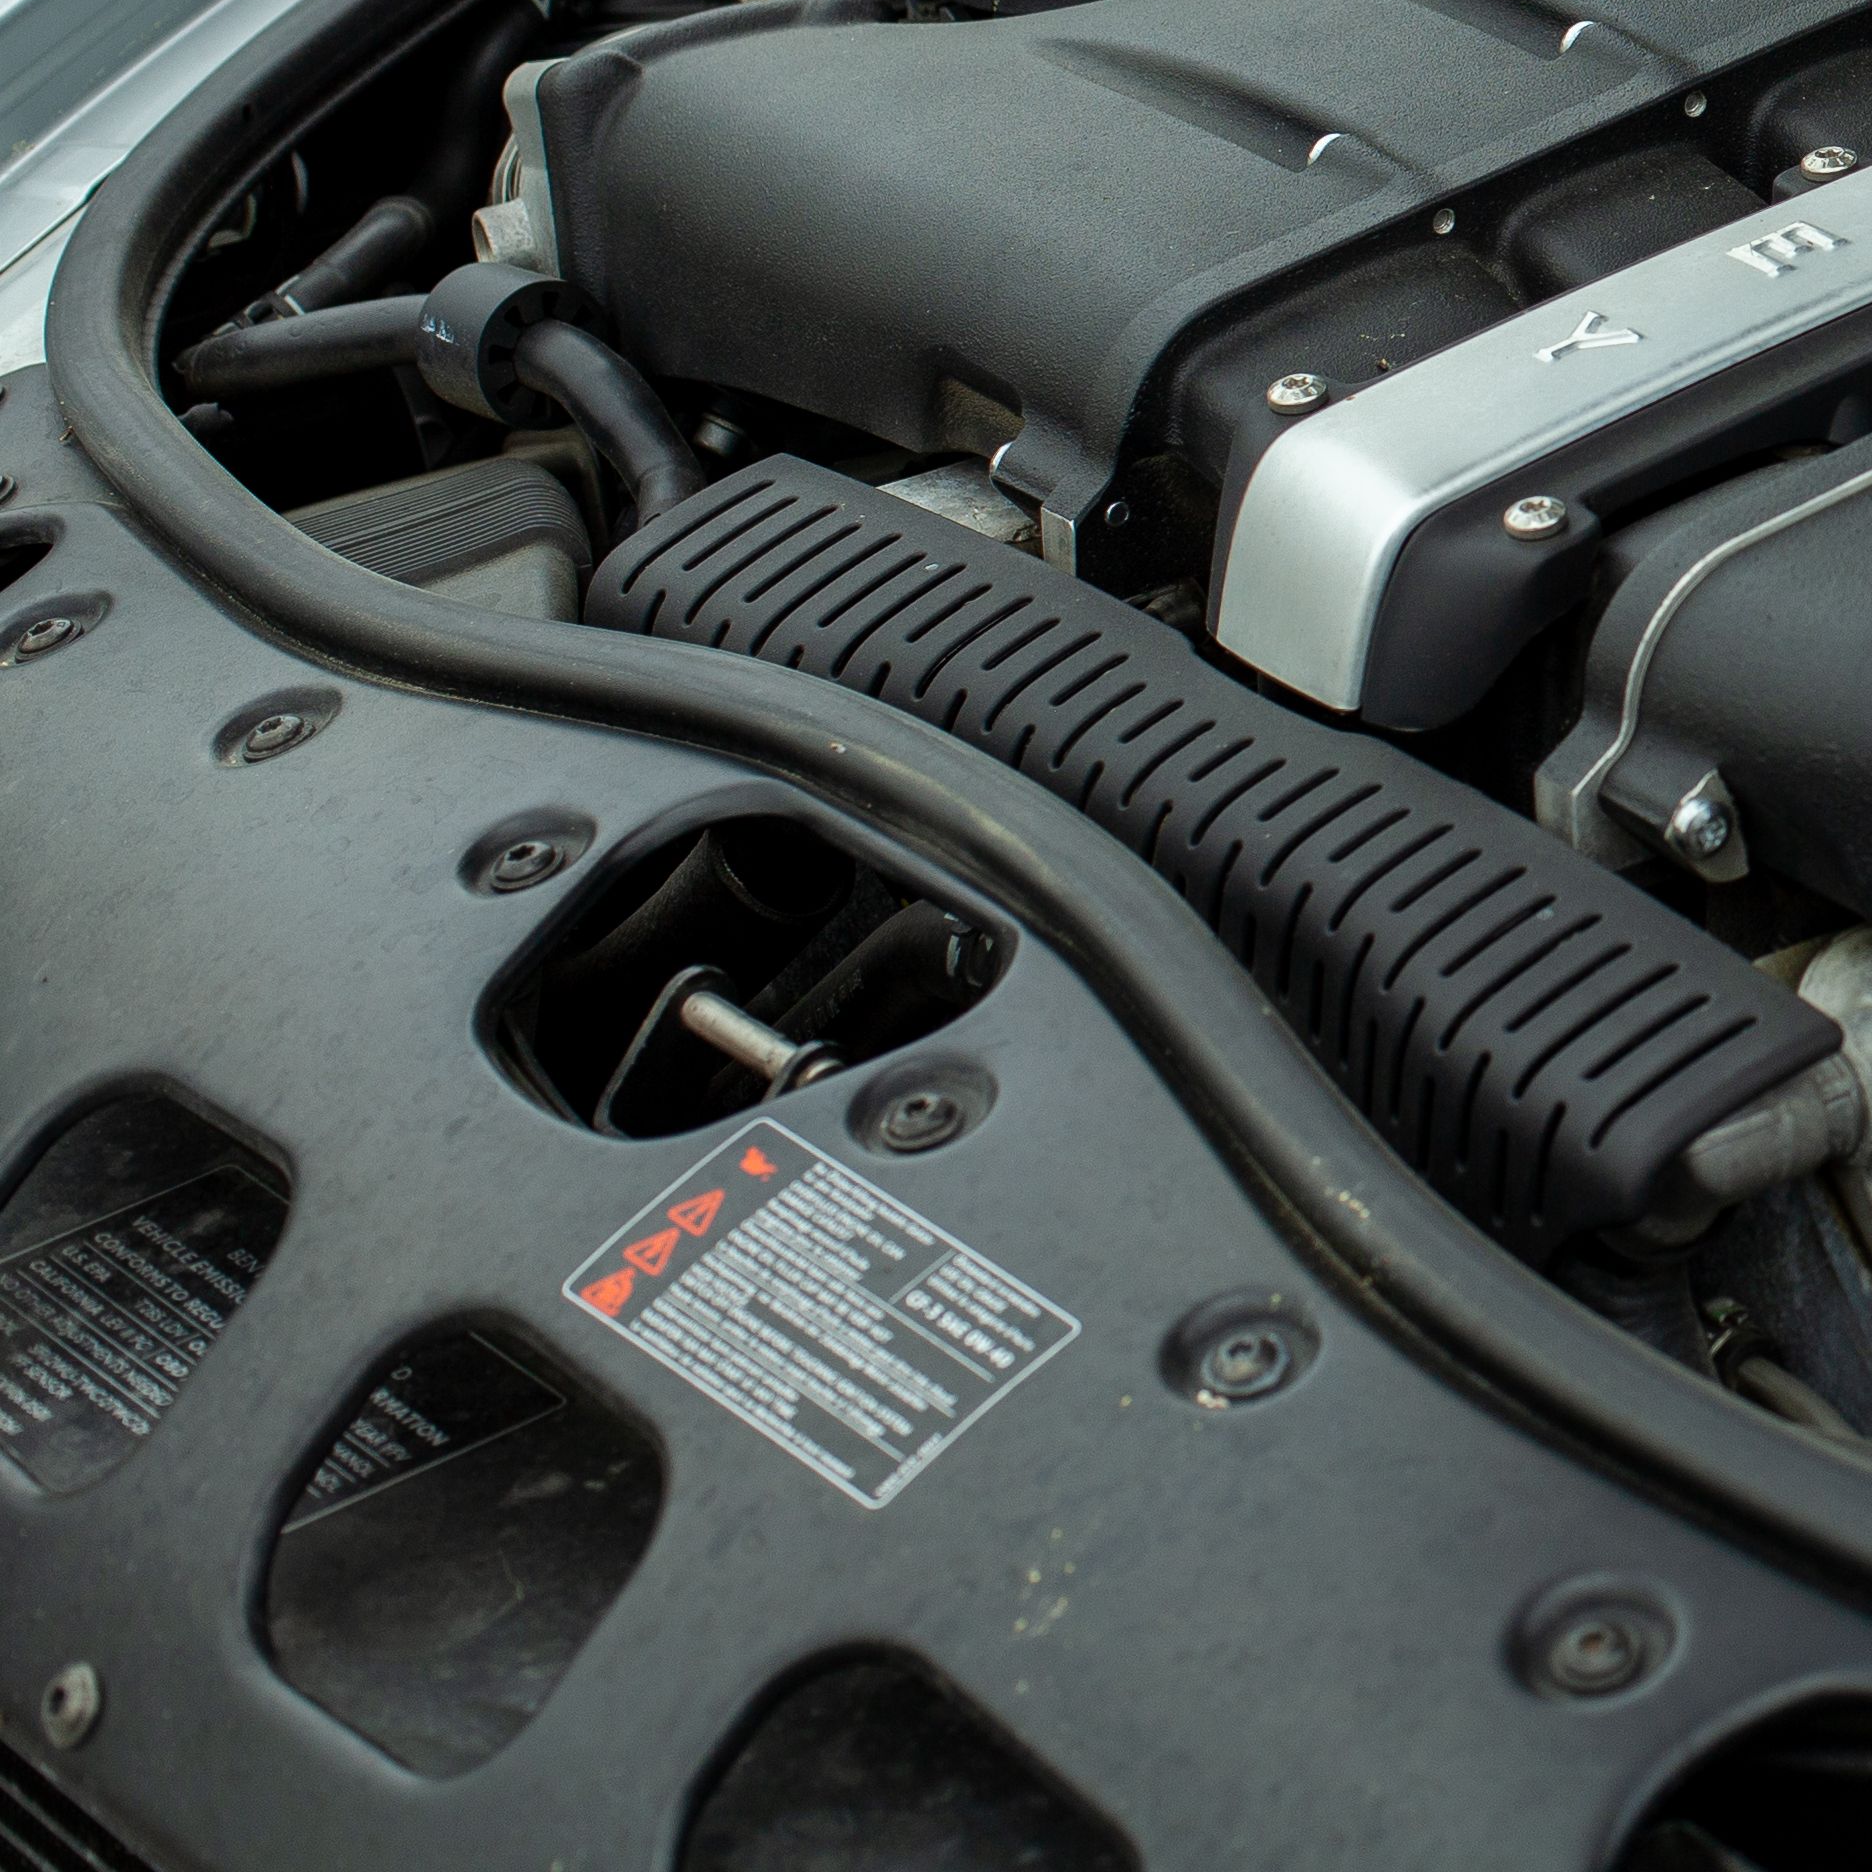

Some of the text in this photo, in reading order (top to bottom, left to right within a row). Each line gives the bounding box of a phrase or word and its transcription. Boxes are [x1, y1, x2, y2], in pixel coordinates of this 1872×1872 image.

[130, 1217, 197, 1262] VEHICLE
[27, 1261, 104, 1313] CALIFORNIA
[85, 1263, 109, 1280] EPA
[91, 1232, 226, 1329] CONFORMS TO REGU
[368, 1389, 451, 1445] RMATION
